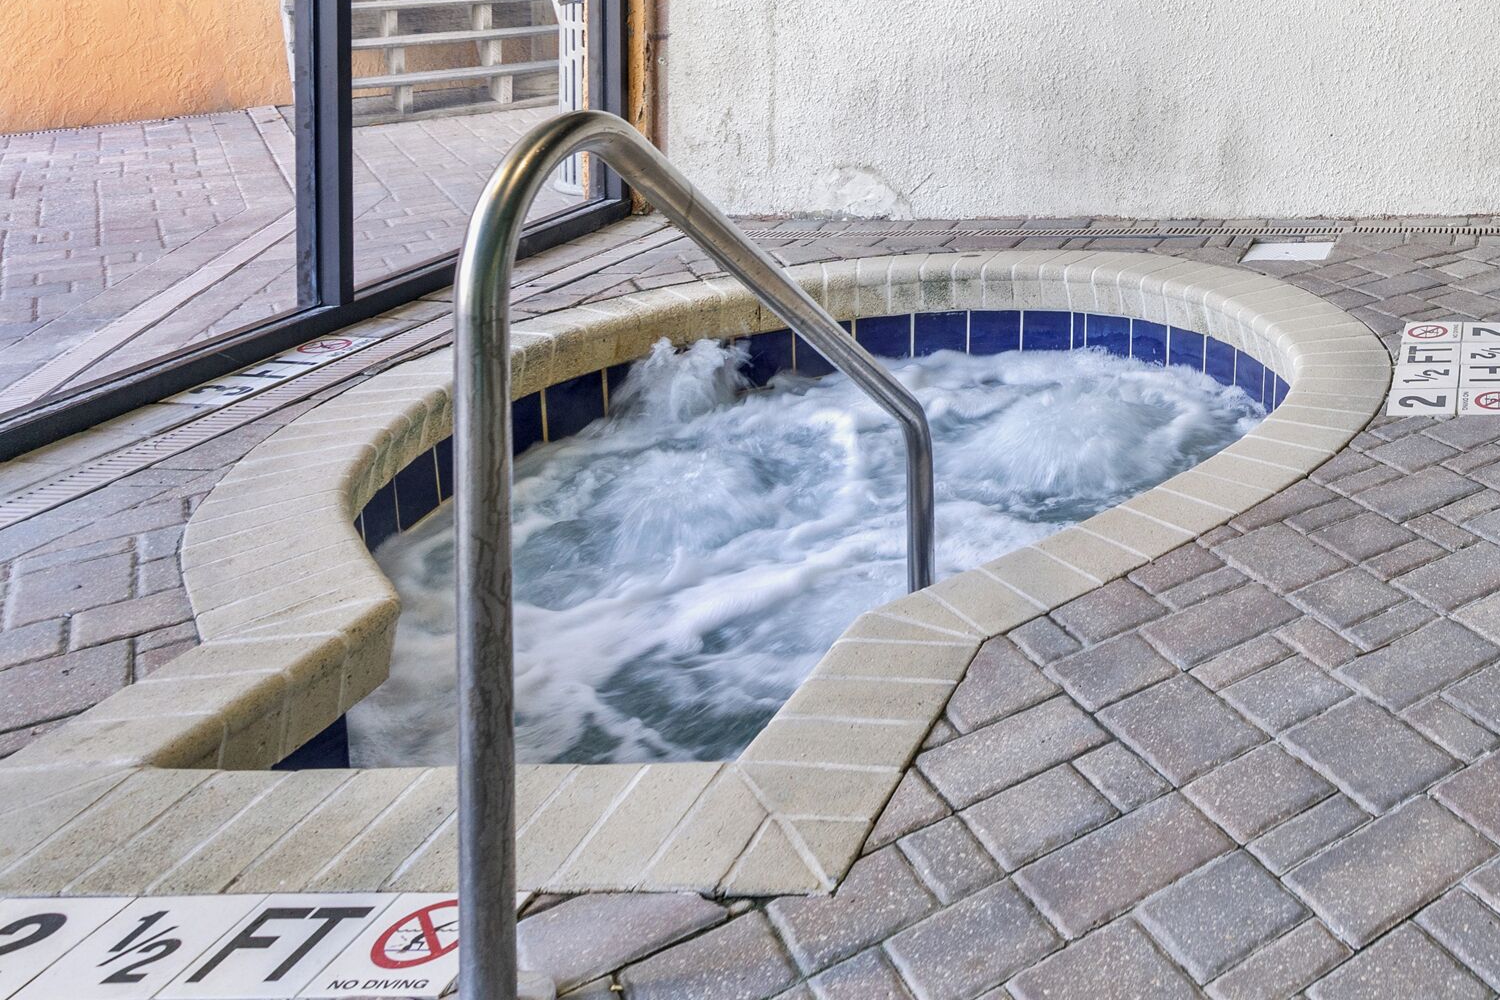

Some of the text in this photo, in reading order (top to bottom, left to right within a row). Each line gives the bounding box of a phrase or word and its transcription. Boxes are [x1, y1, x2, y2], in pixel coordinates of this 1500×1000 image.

[1408, 346, 1452, 363] FT
[1398, 396, 1446, 407] 2
[184, 906, 375, 983] FT
[326, 979, 430, 989] NO DIVING
